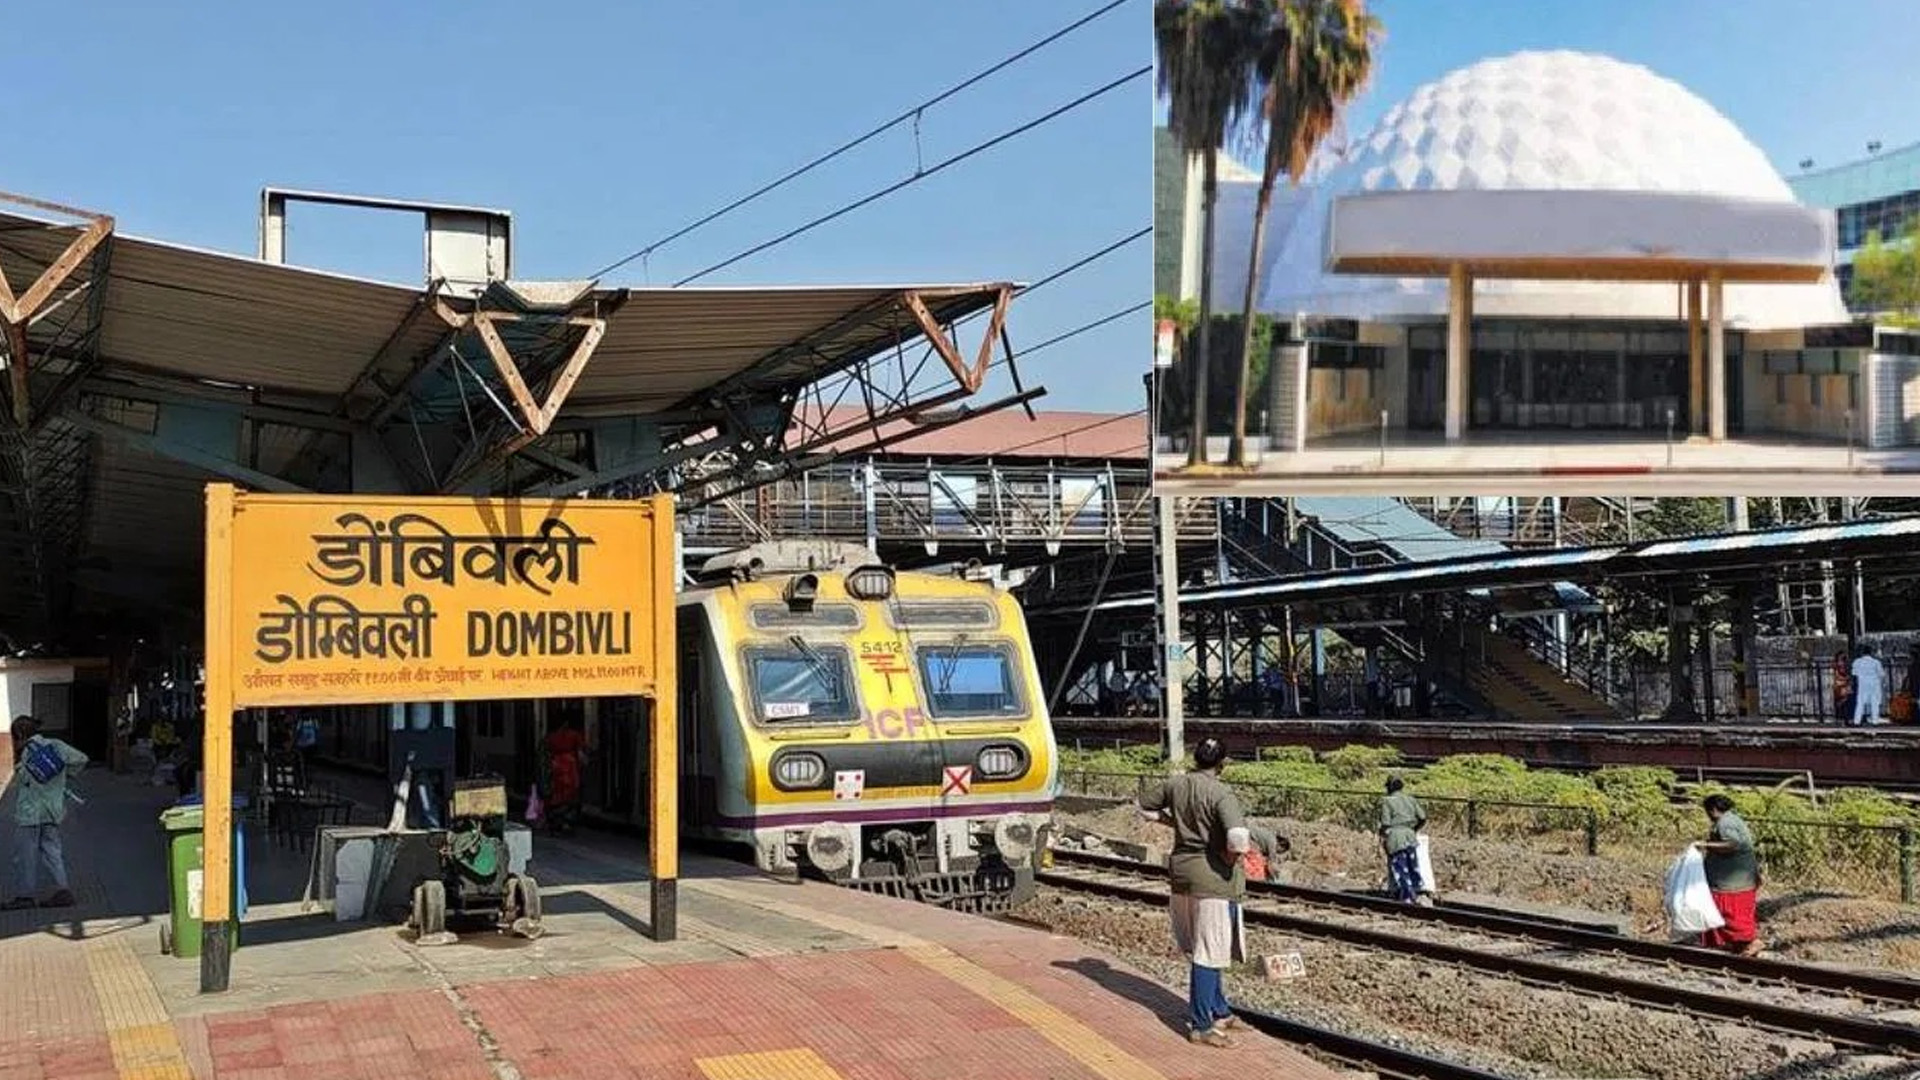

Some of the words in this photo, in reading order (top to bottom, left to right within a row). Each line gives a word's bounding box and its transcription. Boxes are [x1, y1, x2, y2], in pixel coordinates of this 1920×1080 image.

[307, 512, 596, 596] डोंबिवली
[255, 594, 437, 663] डोम्बिवली
[467, 610, 631, 658] DOMBIVLI
[861, 641, 903, 654] 5412
[491, 667, 532, 680] HEIGHT
[535, 667, 570, 679] ABOVE
